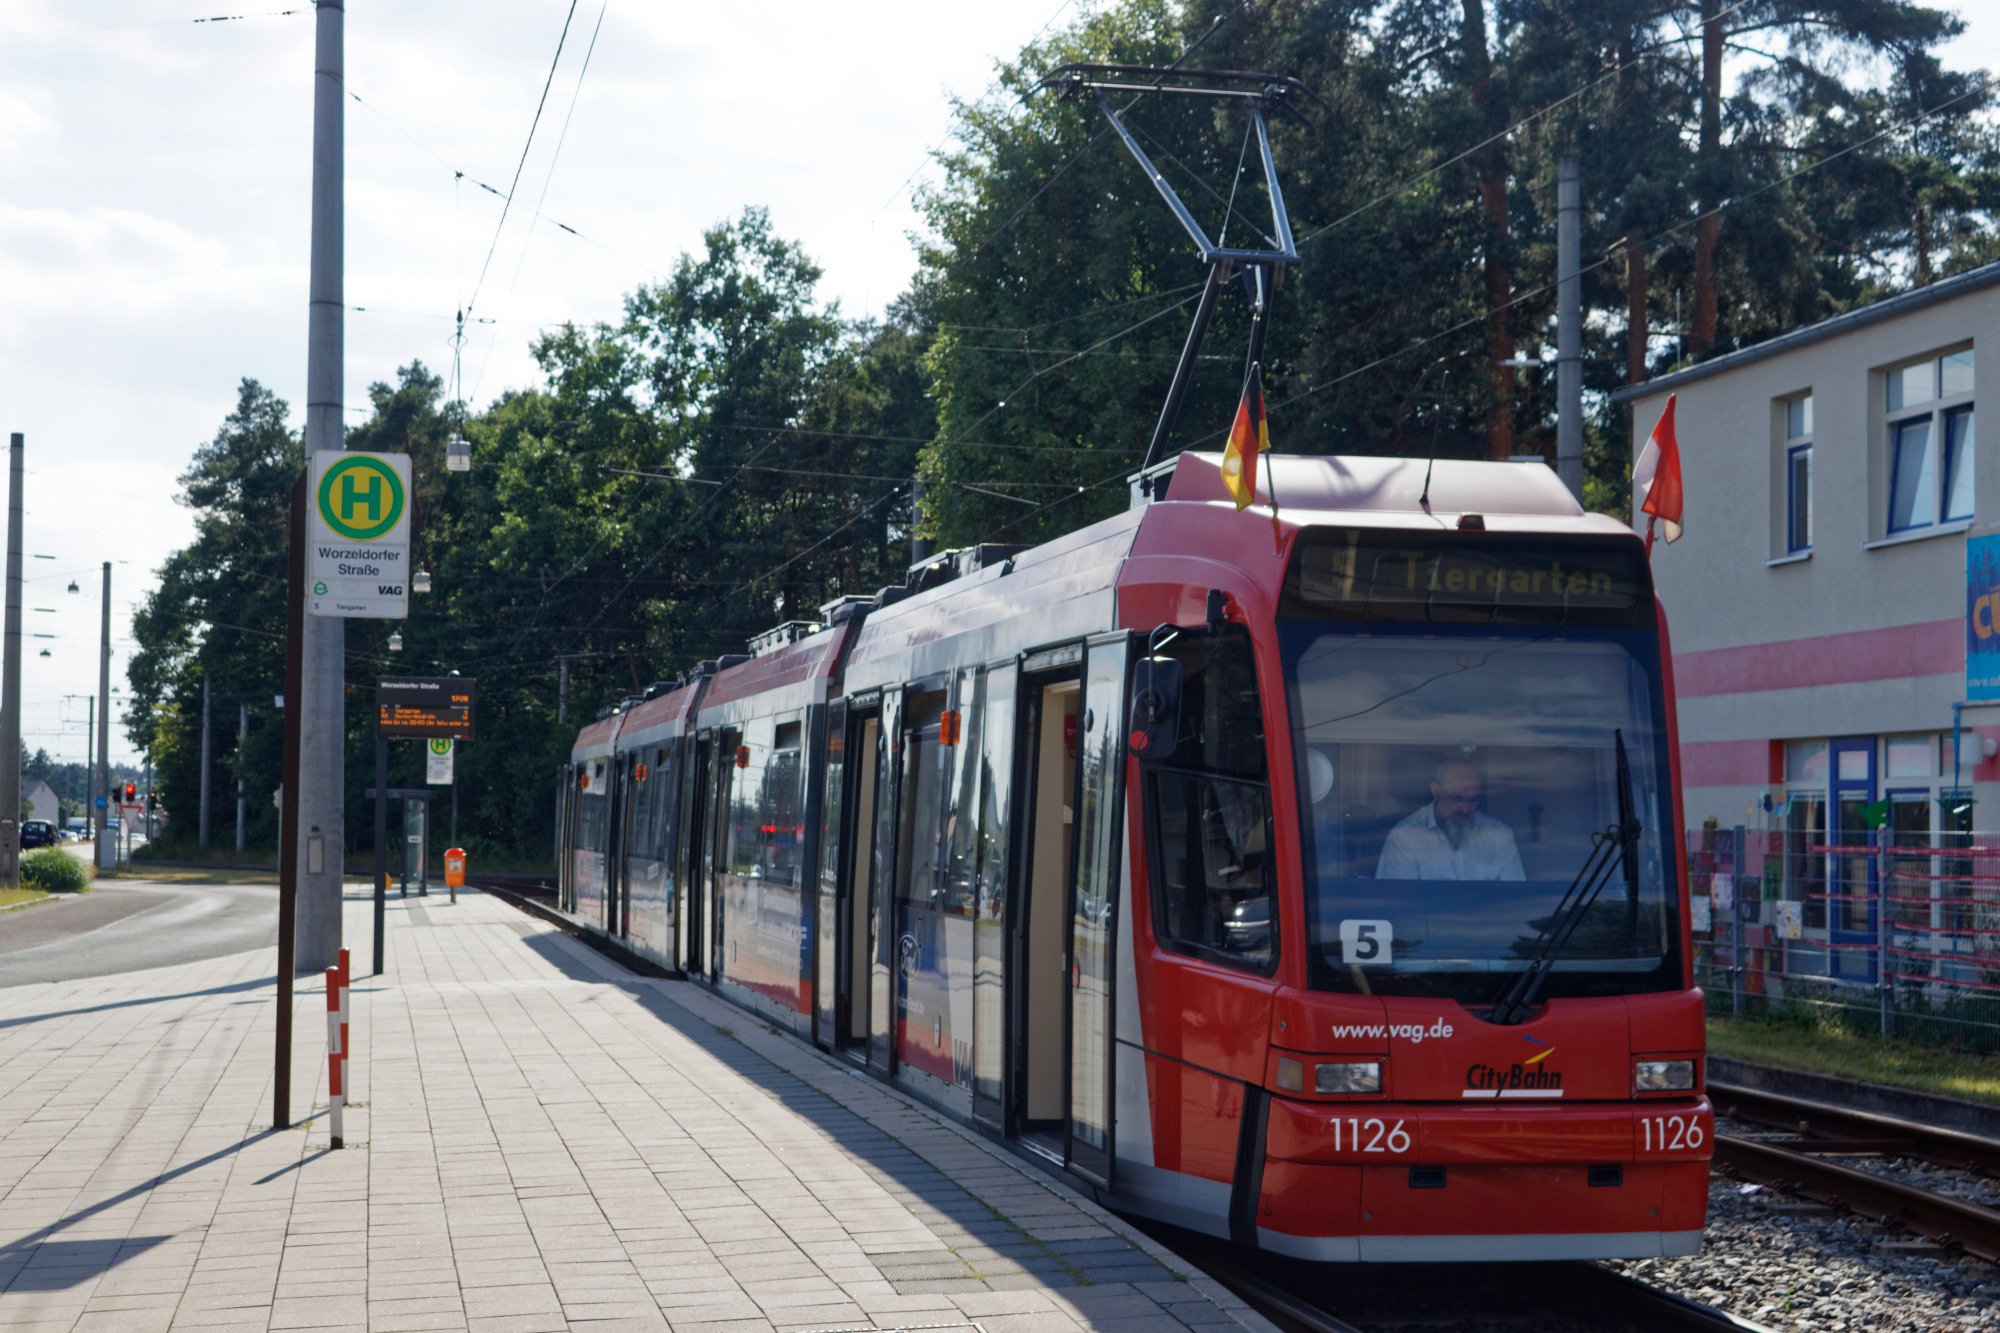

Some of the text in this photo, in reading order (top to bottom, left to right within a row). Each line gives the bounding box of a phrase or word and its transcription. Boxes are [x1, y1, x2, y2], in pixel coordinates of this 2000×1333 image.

[318, 547, 400, 560] Worzeldorfer
[338, 563, 379, 576] Straße
[1399, 552, 1614, 596] Tiergarten
[378, 585, 403, 596] VAG
[314, 602, 320, 610] 5
[336, 603, 367, 611] Tiergarten
[1355, 925, 1380, 960] 5
[1332, 1017, 1453, 1043] www.vag.de
[1330, 1117, 1411, 1154] 1126
[1641, 1114, 1704, 1152] 1126
